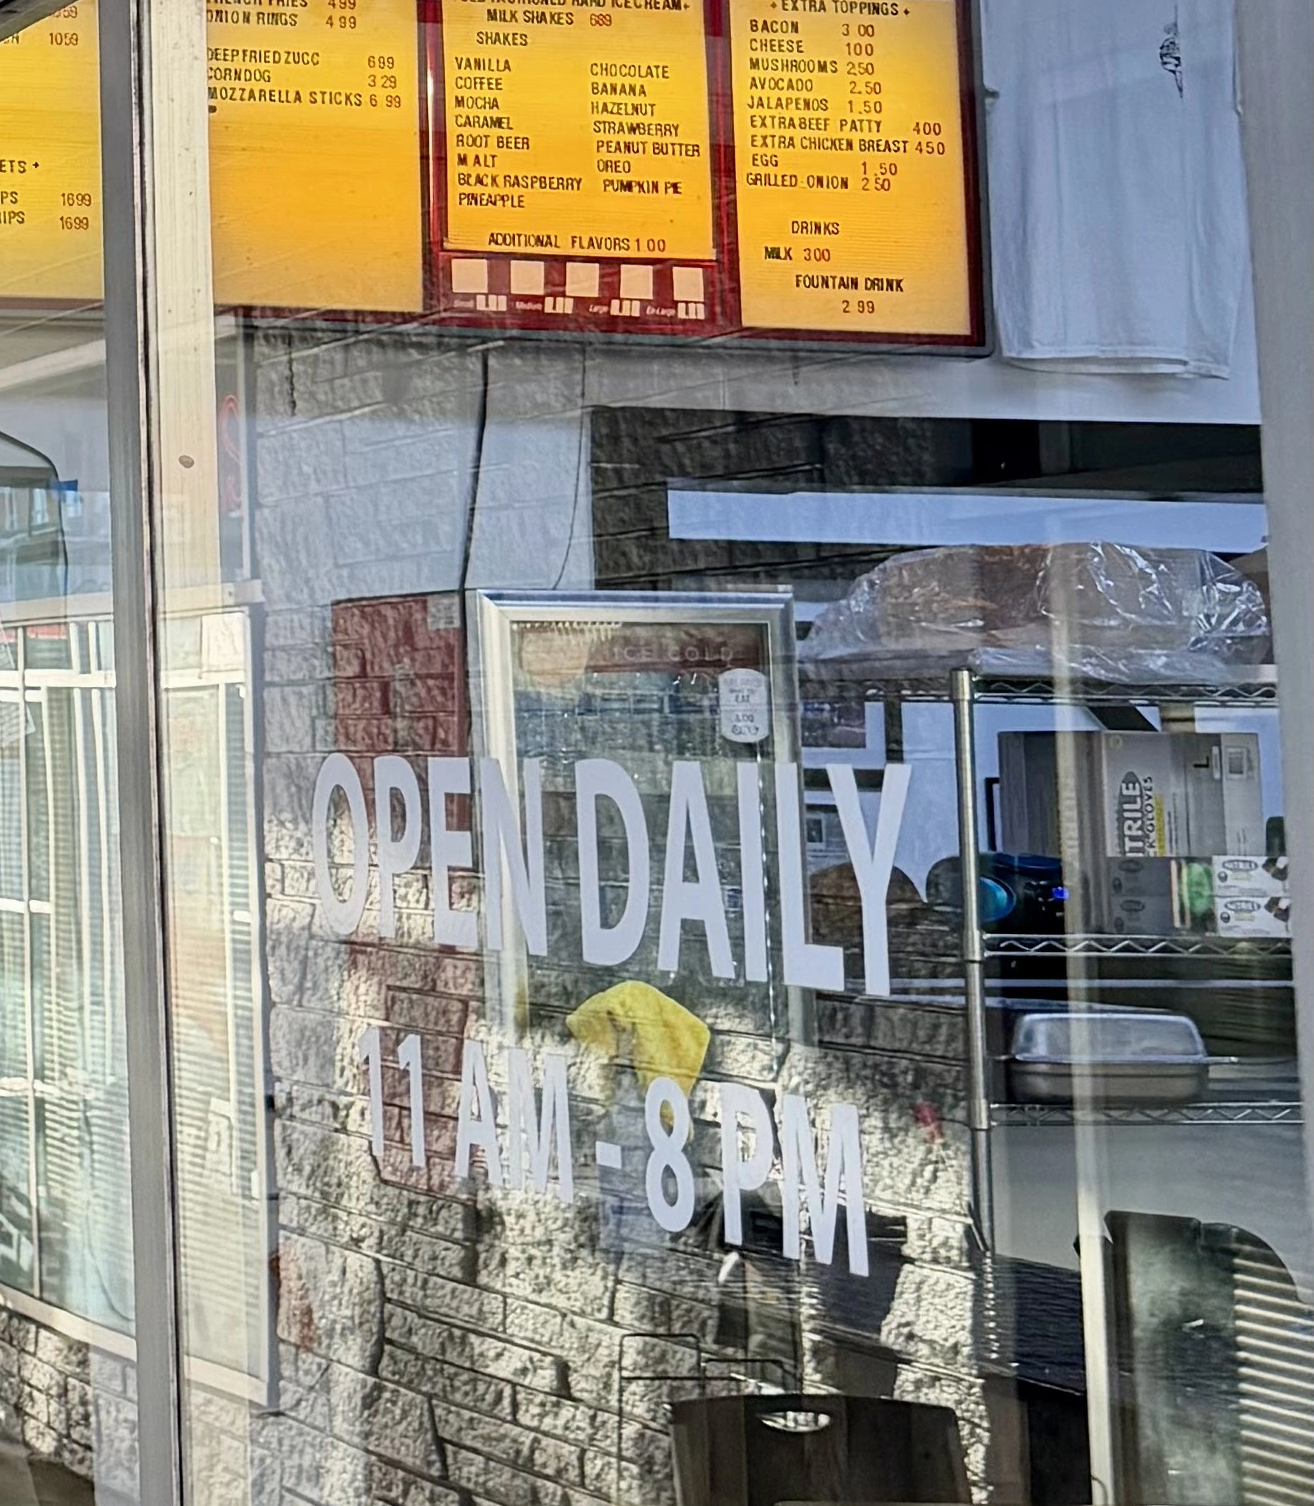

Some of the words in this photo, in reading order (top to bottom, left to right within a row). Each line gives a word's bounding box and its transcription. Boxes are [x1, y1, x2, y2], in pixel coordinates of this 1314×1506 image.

[486, 8, 519, 24] MILK
[522, 10, 575, 26] SHAKES
[832, 0, 900, 16] TOPPINGS
[206, 9, 251, 25] ONION
[256, 12, 299, 27] RINGS
[750, 19, 799, 34] BACON
[476, 30, 528, 46] SHAKES
[750, 39, 805, 54] CHEESE
[454, 56, 512, 73] VANILLA
[590, 62, 670, 79] CHOCOLATE
[749, 57, 839, 74] MUSHROOMS
[454, 76, 503, 91] COFFEE
[591, 82, 647, 98] BANANA
[749, 76, 813, 92] AVOCADO
[207, 86, 303, 104] MOZZARELLA
[309, 91, 363, 107] STICKS
[747, 95, 829, 112] JALAPENOS
[454, 95, 500, 110] MOCHA
[590, 101, 656, 118] HAZELNUT
[455, 114, 514, 130] CARAMEL
[593, 120, 679, 138] STRAWBERRY
[840, 119, 882, 134] PATTY
[456, 134, 489, 149] ROOT
[496, 136, 530, 151] BEER
[596, 140, 647, 156] PEANUT
[652, 142, 700, 158] BUTTER
[750, 135, 796, 150] EXTRA
[800, 136, 854, 152] CHICKEN
[858, 139, 910, 154] BREAST
[597, 159, 632, 174] OREO
[751, 153, 779, 167] EGG
[458, 173, 499, 188] BLACK
[503, 175, 583, 192] RASPBERRY
[603, 179, 659, 194] PUMPKIN
[664, 180, 683, 195] PIE
[746, 172, 798, 188] GRILLED
[806, 175, 849, 190] ONION
[458, 193, 525, 209] PINEAPPLE
[791, 220, 840, 237] DRINKS
[488, 232, 561, 250] ADDITIONAL
[571, 235, 631, 251] FLAVORS
[764, 246, 793, 261] MILK
[795, 274, 859, 291] FOUNTAIN
[864, 276, 906, 293] DRINK
[1123, 782, 1143, 857] ITRILE
[311, 752, 548, 958] OPEN
[574, 758, 912, 996] DAILY
[358, 1025, 425, 1169] 11
[454, 1040, 573, 1203] AM
[644, 1076, 695, 1233] 8
[718, 1081, 870, 1278] PM
